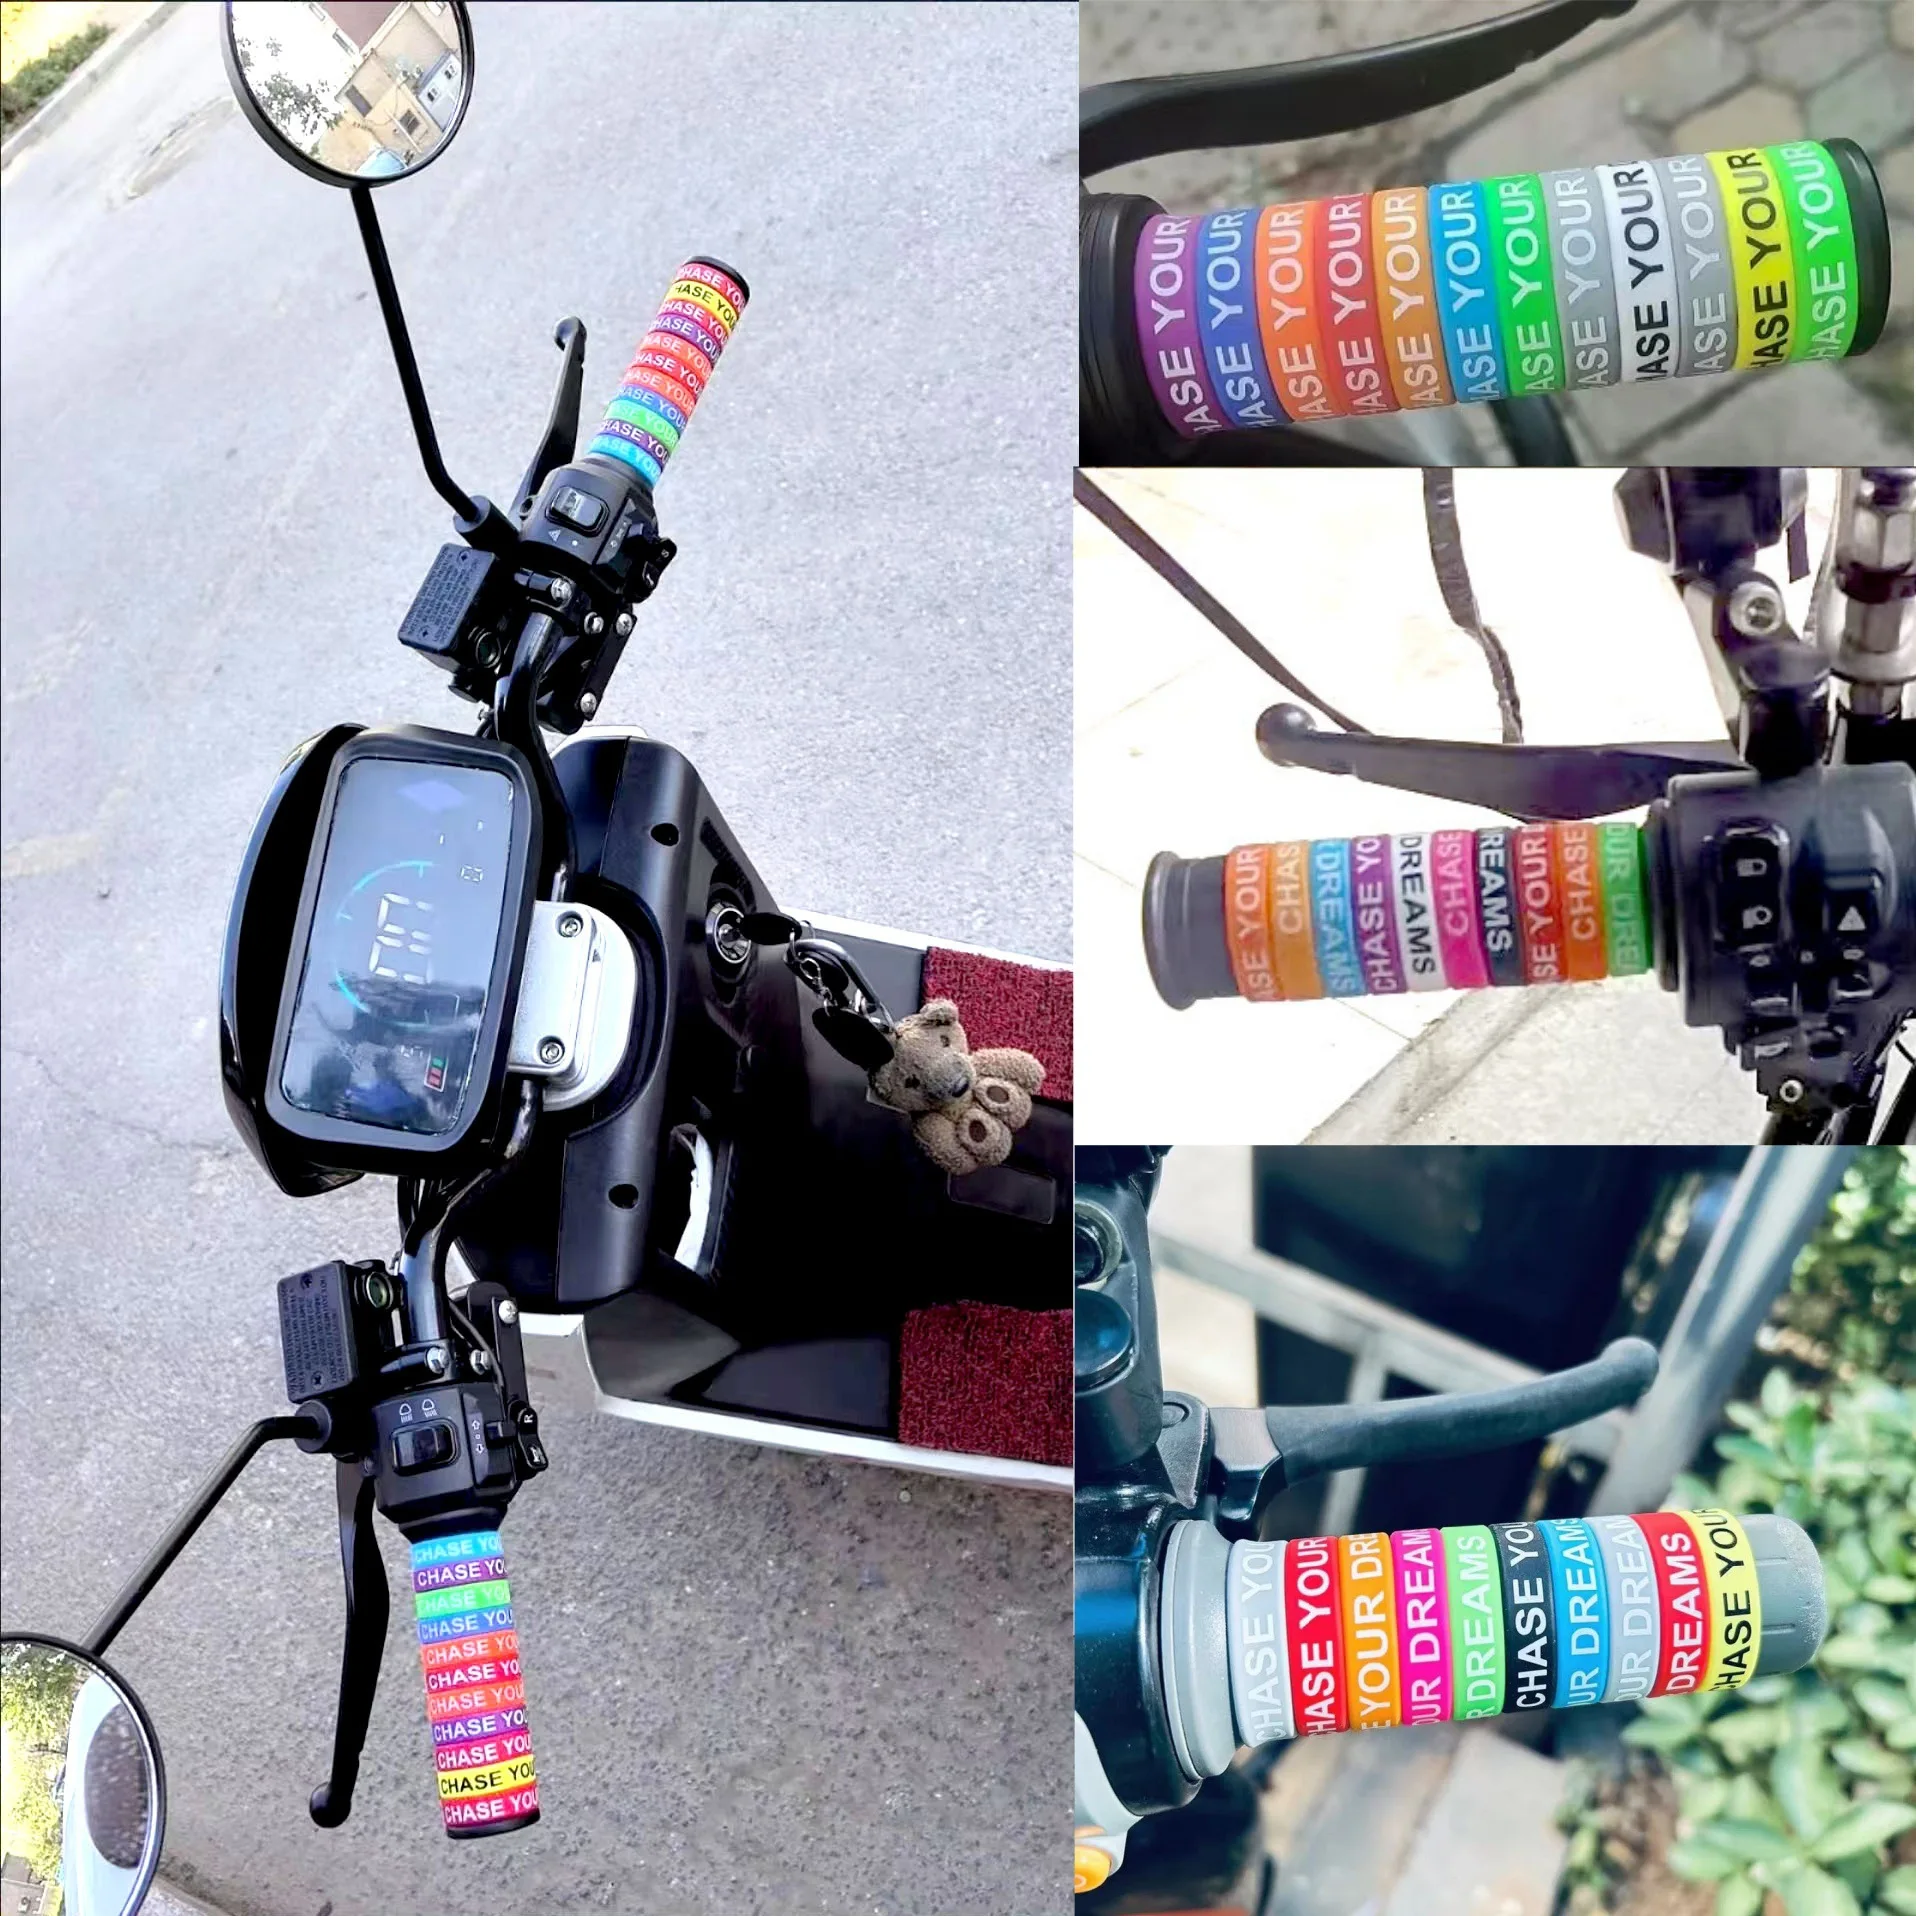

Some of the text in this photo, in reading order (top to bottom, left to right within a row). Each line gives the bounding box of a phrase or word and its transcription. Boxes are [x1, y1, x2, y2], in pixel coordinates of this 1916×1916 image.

[1499, 178, 1543, 308] YOUR
[1554, 175, 1600, 304] YOUR
[1668, 156, 1720, 281] YOUR
[1726, 151, 1782, 270] YOUR
[1780, 143, 1840, 251] YOUR
[1150, 217, 1191, 335] YOUR
[1207, 210, 1247, 331] YOUR
[1268, 203, 1334, 421] ASE YOUR
[1328, 197, 1389, 414] ASE YOUR
[1385, 193, 1424, 321] YOUR
[1441, 189, 1501, 401] ASE YOUR
[1613, 167, 1671, 382] ASE YOUR
[1234, 847, 1263, 940] YOUR
[1358, 881, 1398, 991] CHASE
[1400, 836, 1437, 975] DREAMS
[1437, 833, 1470, 937] CHASE
[1563, 827, 1598, 941] CHASE
[417, 1561, 482, 1587] CHASE
[421, 1613, 480, 1640] CHASE
[1297, 1537, 1331, 1629] YOUR
[1456, 1535, 1497, 1702] DREAMS
[1659, 1532, 1703, 1696] DREAMS
[426, 1638, 490, 1665] CHASE
[428, 1662, 497, 1690] CHASE
[1242, 1612, 1283, 1742] CHASE
[1353, 1591, 1391, 1717] YOUR
[1512, 1577, 1548, 1709] CHASE
[430, 1690, 488, 1715] CHASE
[434, 1715, 497, 1742] CHASE
[437, 1743, 499, 1769] CHASE
[440, 1770, 504, 1795] CHASE
[444, 1798, 505, 1823] CHASE
